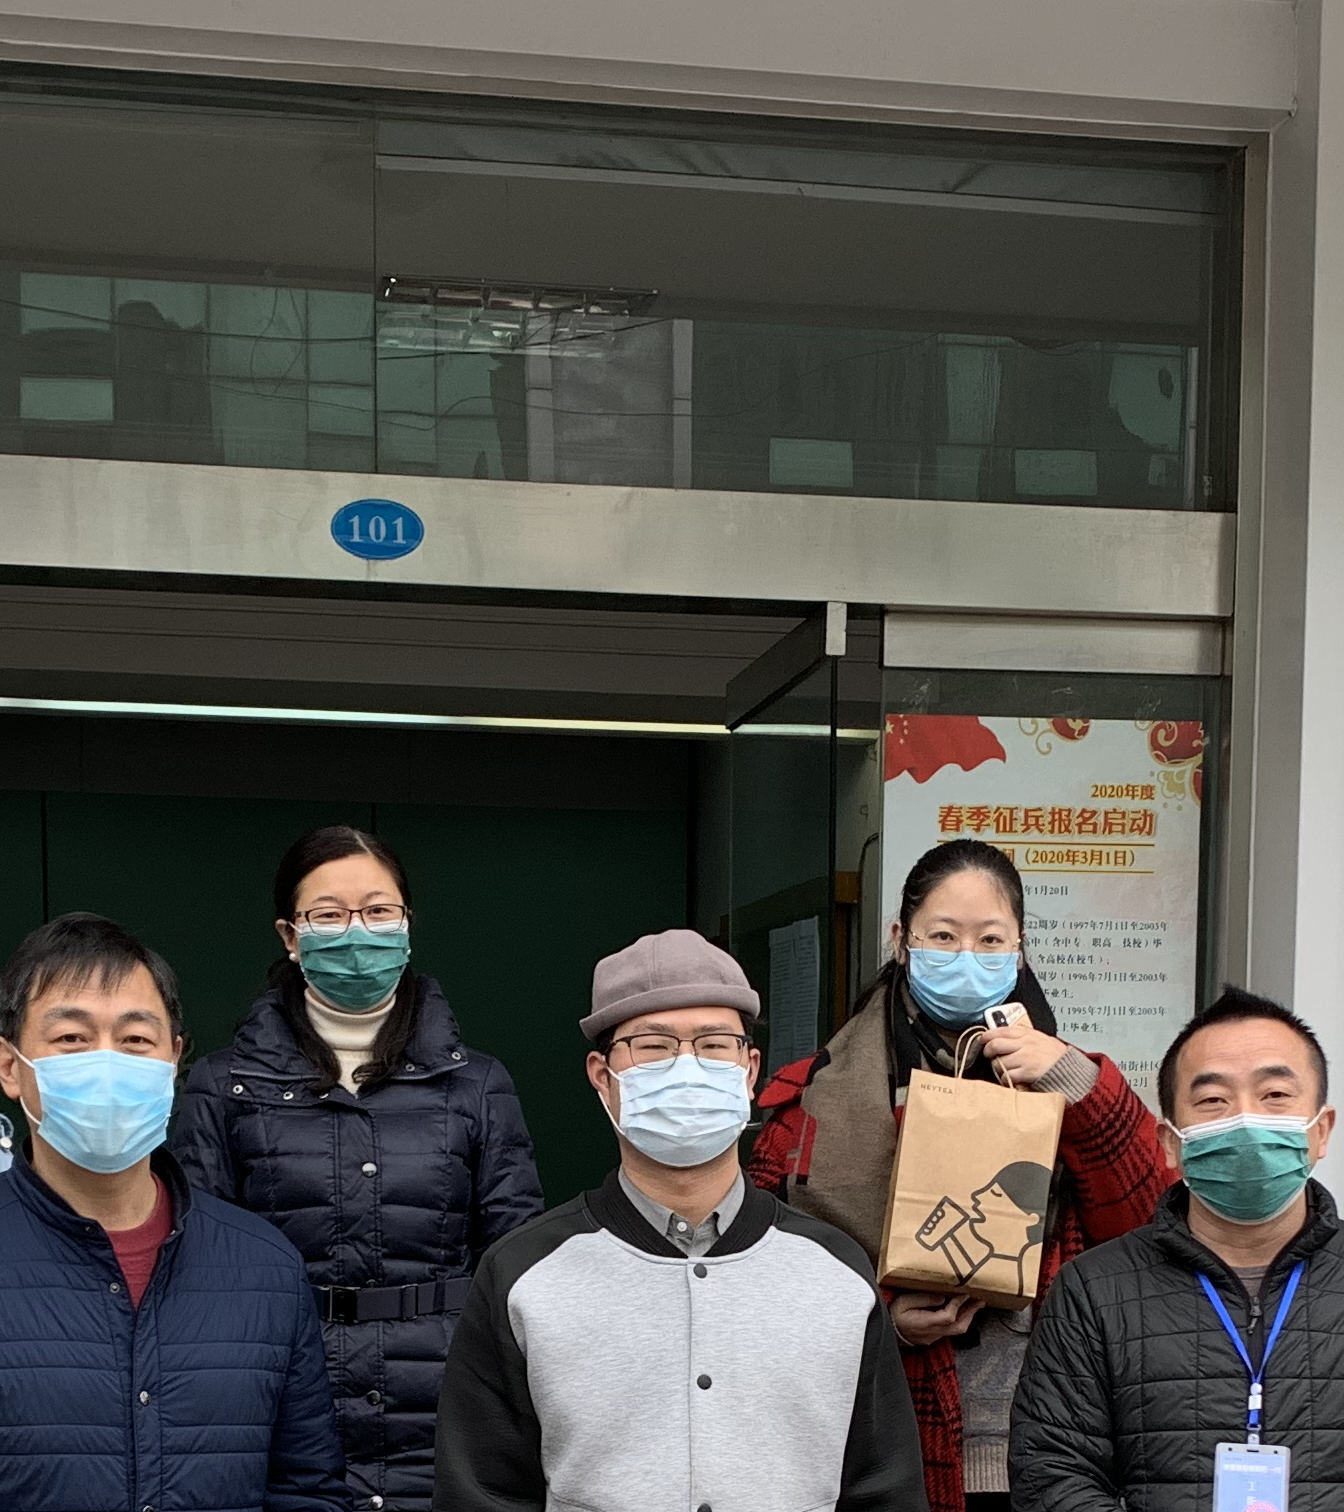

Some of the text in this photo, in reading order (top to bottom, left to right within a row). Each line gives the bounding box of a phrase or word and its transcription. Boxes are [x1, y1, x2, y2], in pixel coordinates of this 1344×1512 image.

[348, 514, 407, 544] 101
[1090, 783, 1156, 800] 2020年度
[937, 804, 1156, 837] 春季征兵报名启动
[920, 1083, 953, 1095] HEYTEA
